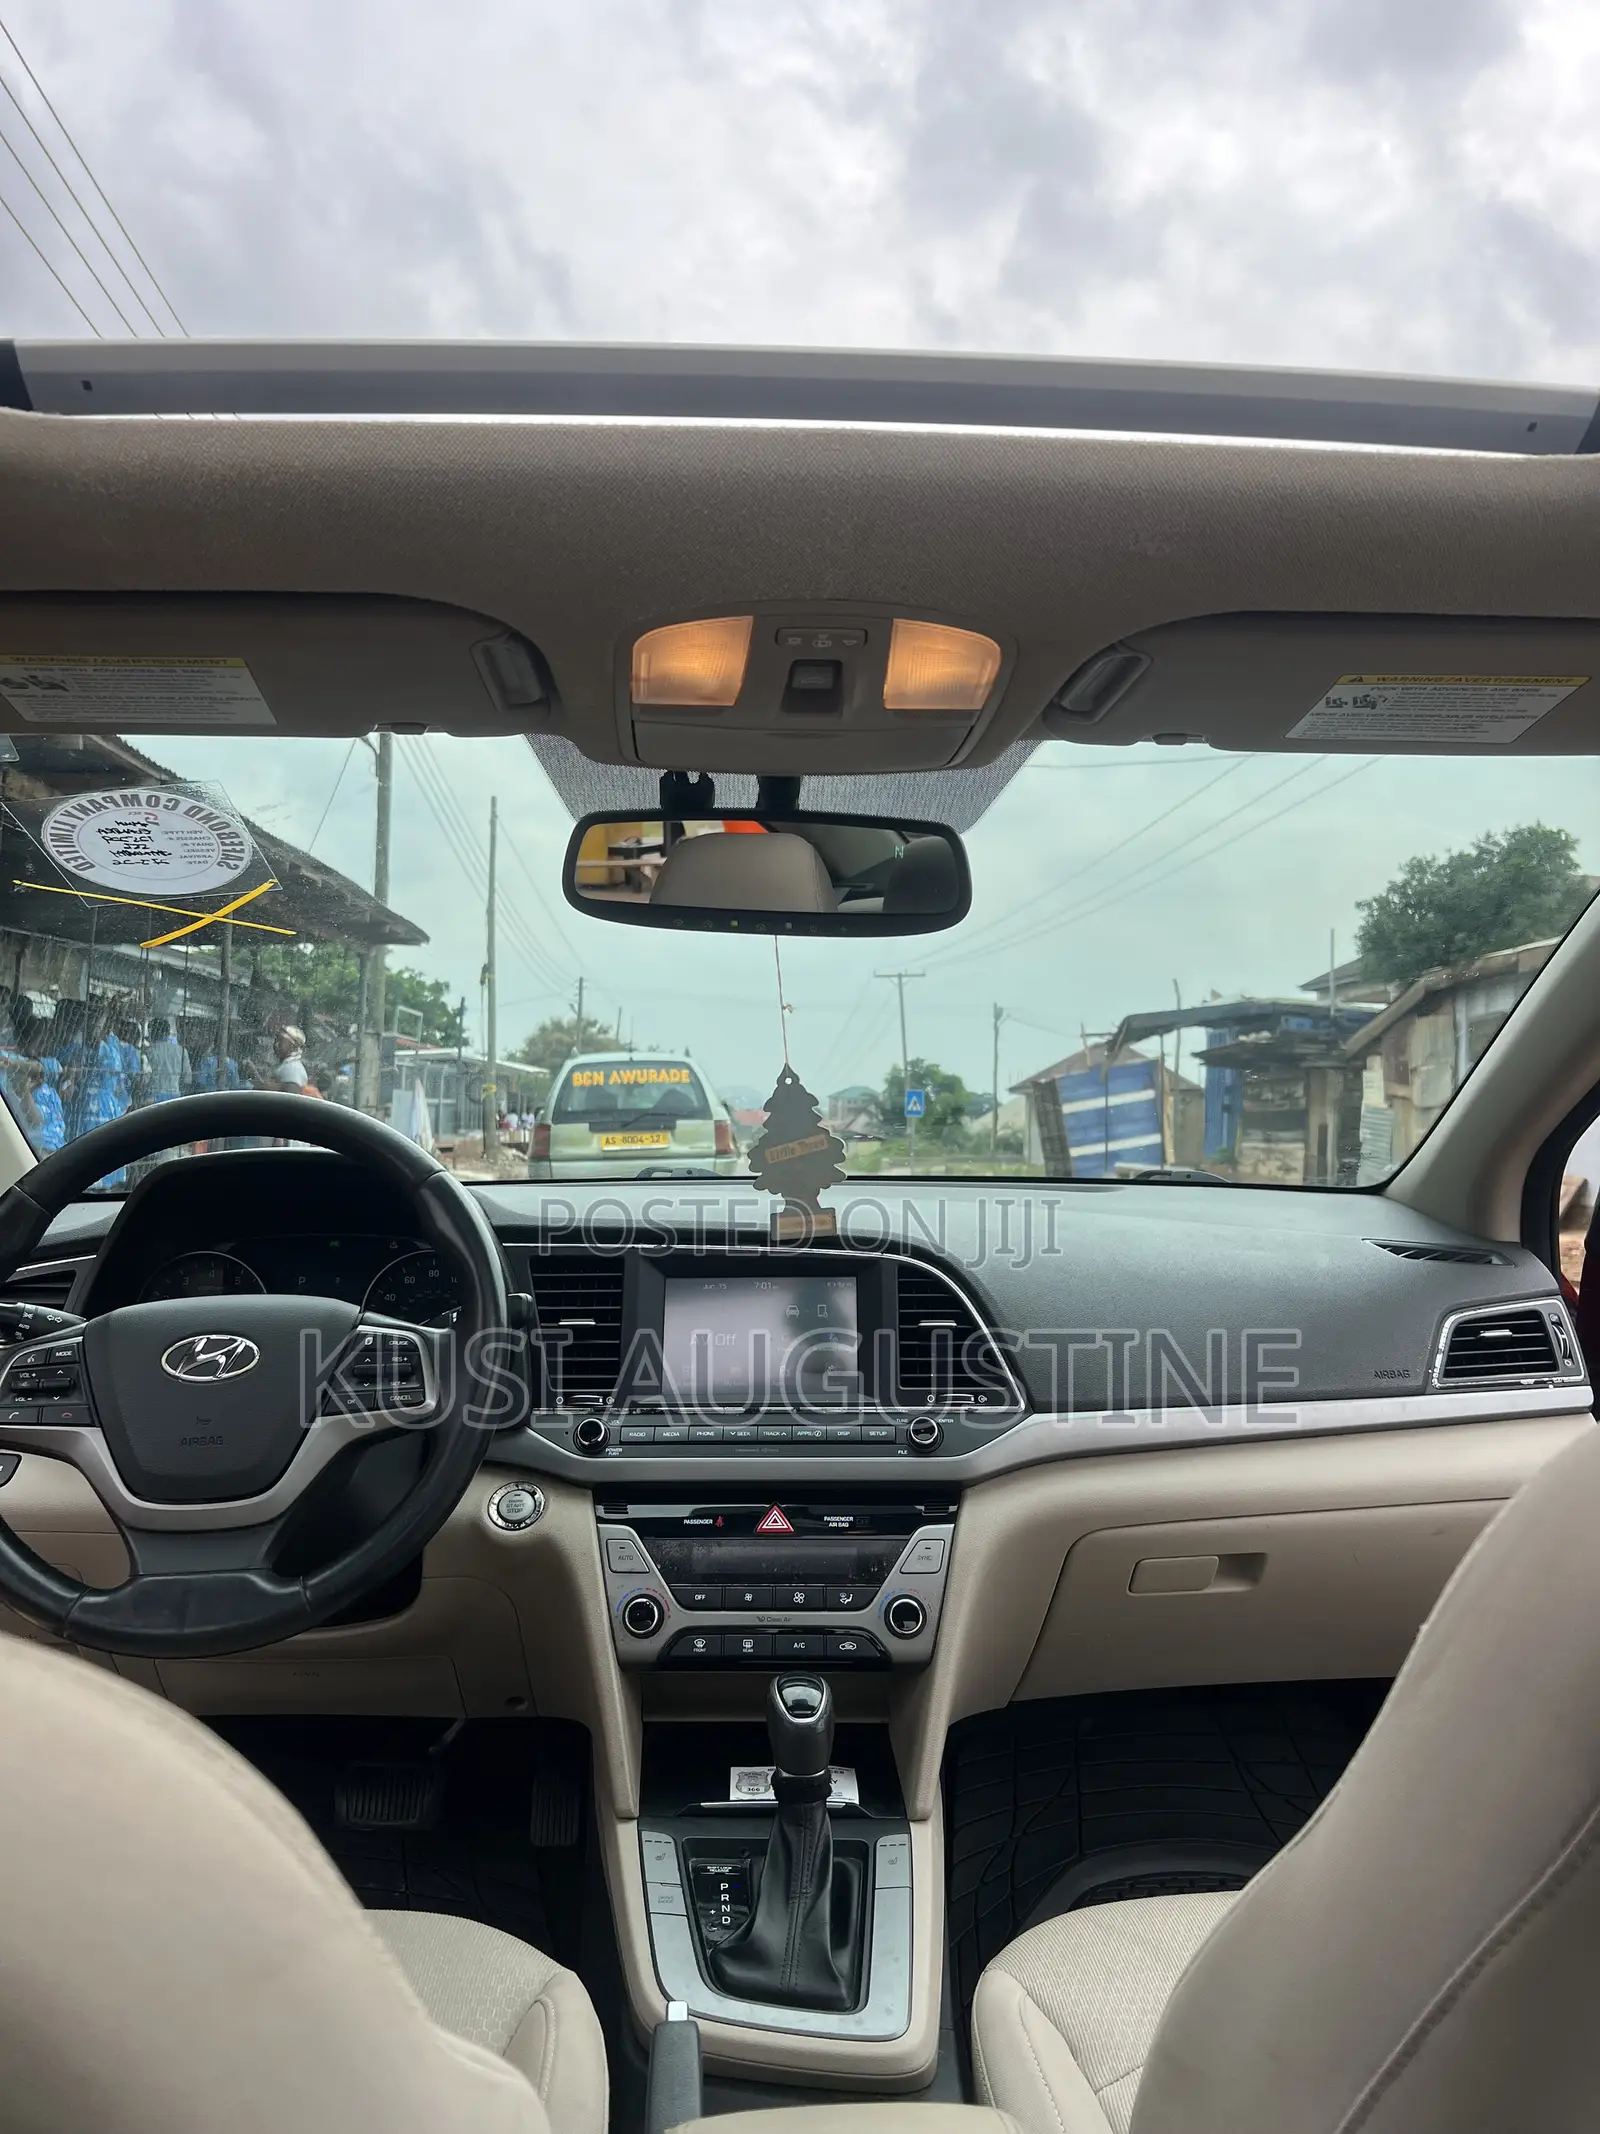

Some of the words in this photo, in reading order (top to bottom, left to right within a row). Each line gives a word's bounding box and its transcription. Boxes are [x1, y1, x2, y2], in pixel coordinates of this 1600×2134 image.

[608, 1068, 691, 1085] AWURADE
[715, 1333, 738, 1346] Off
[1373, 1369, 1411, 1379] AIRBAG
[181, 1435, 224, 1446] AIRBAG
[720, 1882, 729, 1891] P
[720, 1893, 730, 1902] R
[721, 1904, 731, 1913] N
[721, 1916, 731, 1924] D
